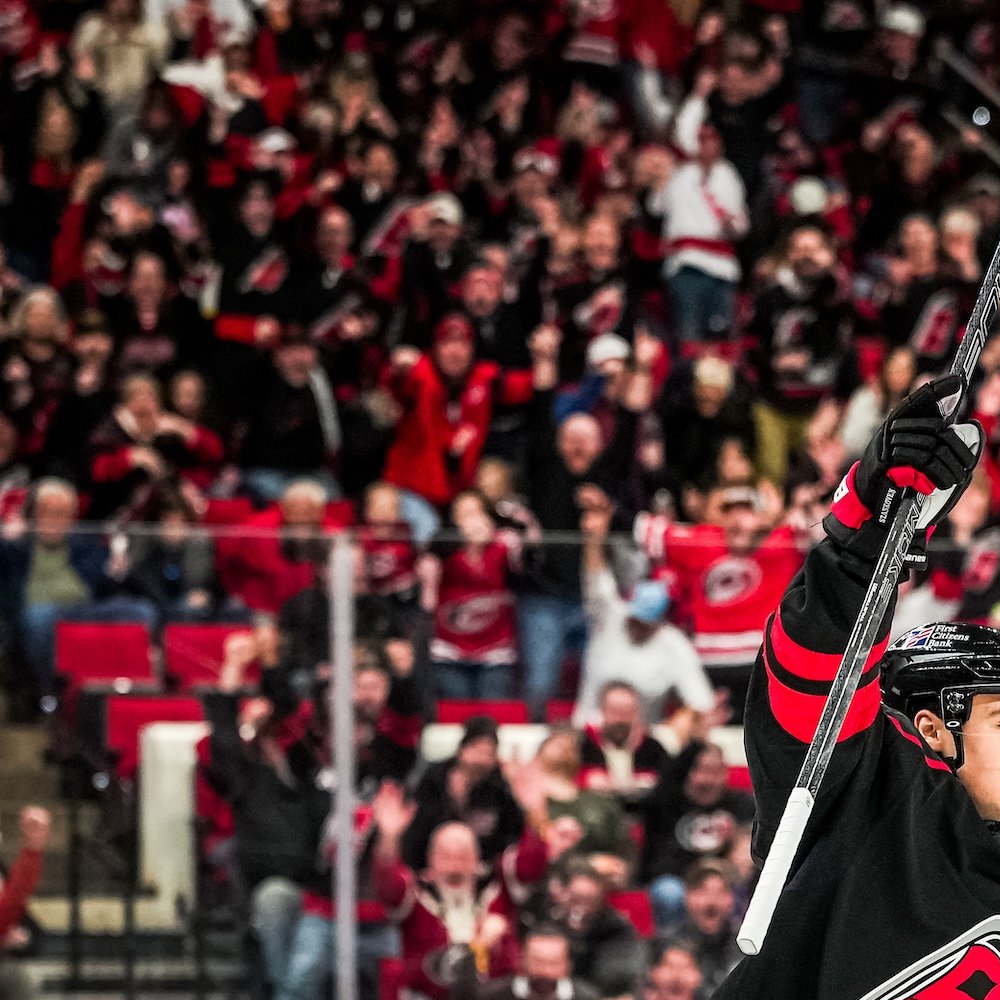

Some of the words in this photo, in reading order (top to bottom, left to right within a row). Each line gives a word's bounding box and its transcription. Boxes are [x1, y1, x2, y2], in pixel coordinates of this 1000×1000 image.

[878, 487, 897, 524] STANKOVEN
[935, 624, 958, 632] First
[931, 632, 970, 641] Citizens
[928, 639, 953, 648] Bank
